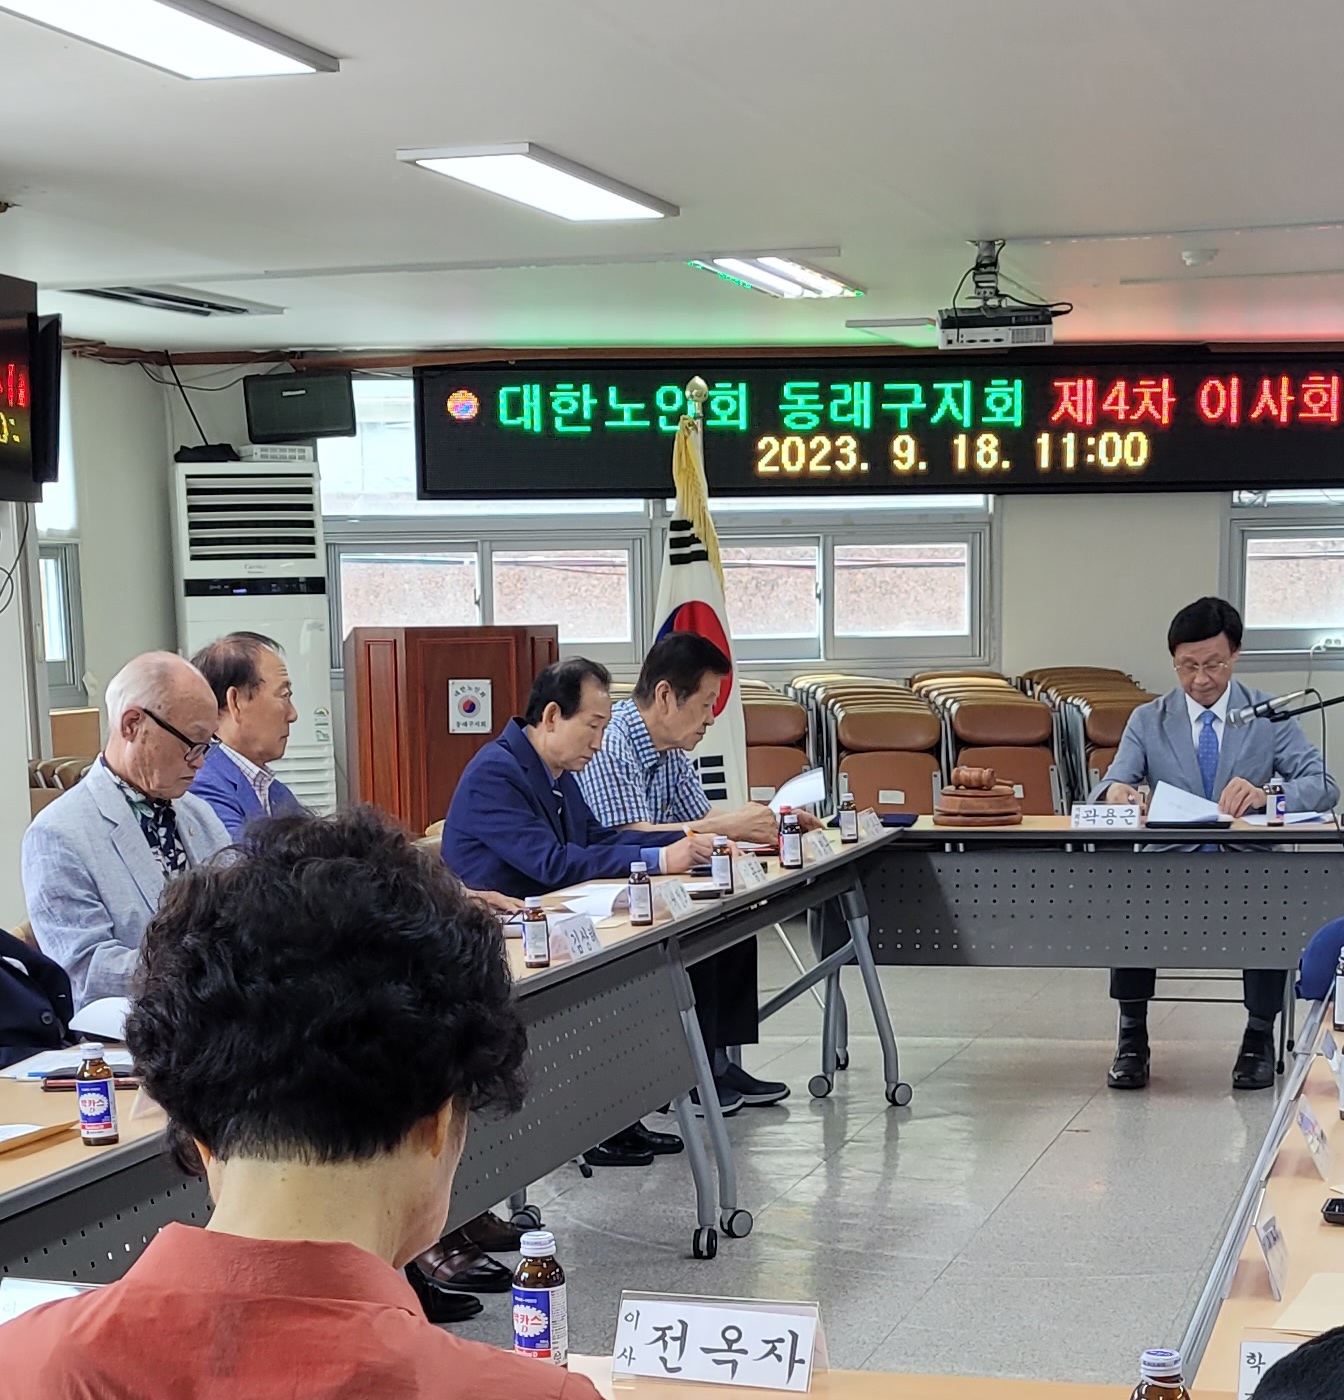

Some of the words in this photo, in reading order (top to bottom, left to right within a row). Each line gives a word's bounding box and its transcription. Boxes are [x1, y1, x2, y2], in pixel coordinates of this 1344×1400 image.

[499, 382, 748, 433] 대한노인회
[778, 379, 1023, 430] 동래구지회
[1050, 378, 1177, 425] 제4차
[757, 435, 869, 472] 2023.
[892, 434, 928, 470] 9.
[953, 433, 1011, 470] 18.
[1036, 432, 1149, 468] 11:00
[1082, 808, 1136, 826] 곽용근
[644, 1318, 806, 1385] 전옥자
